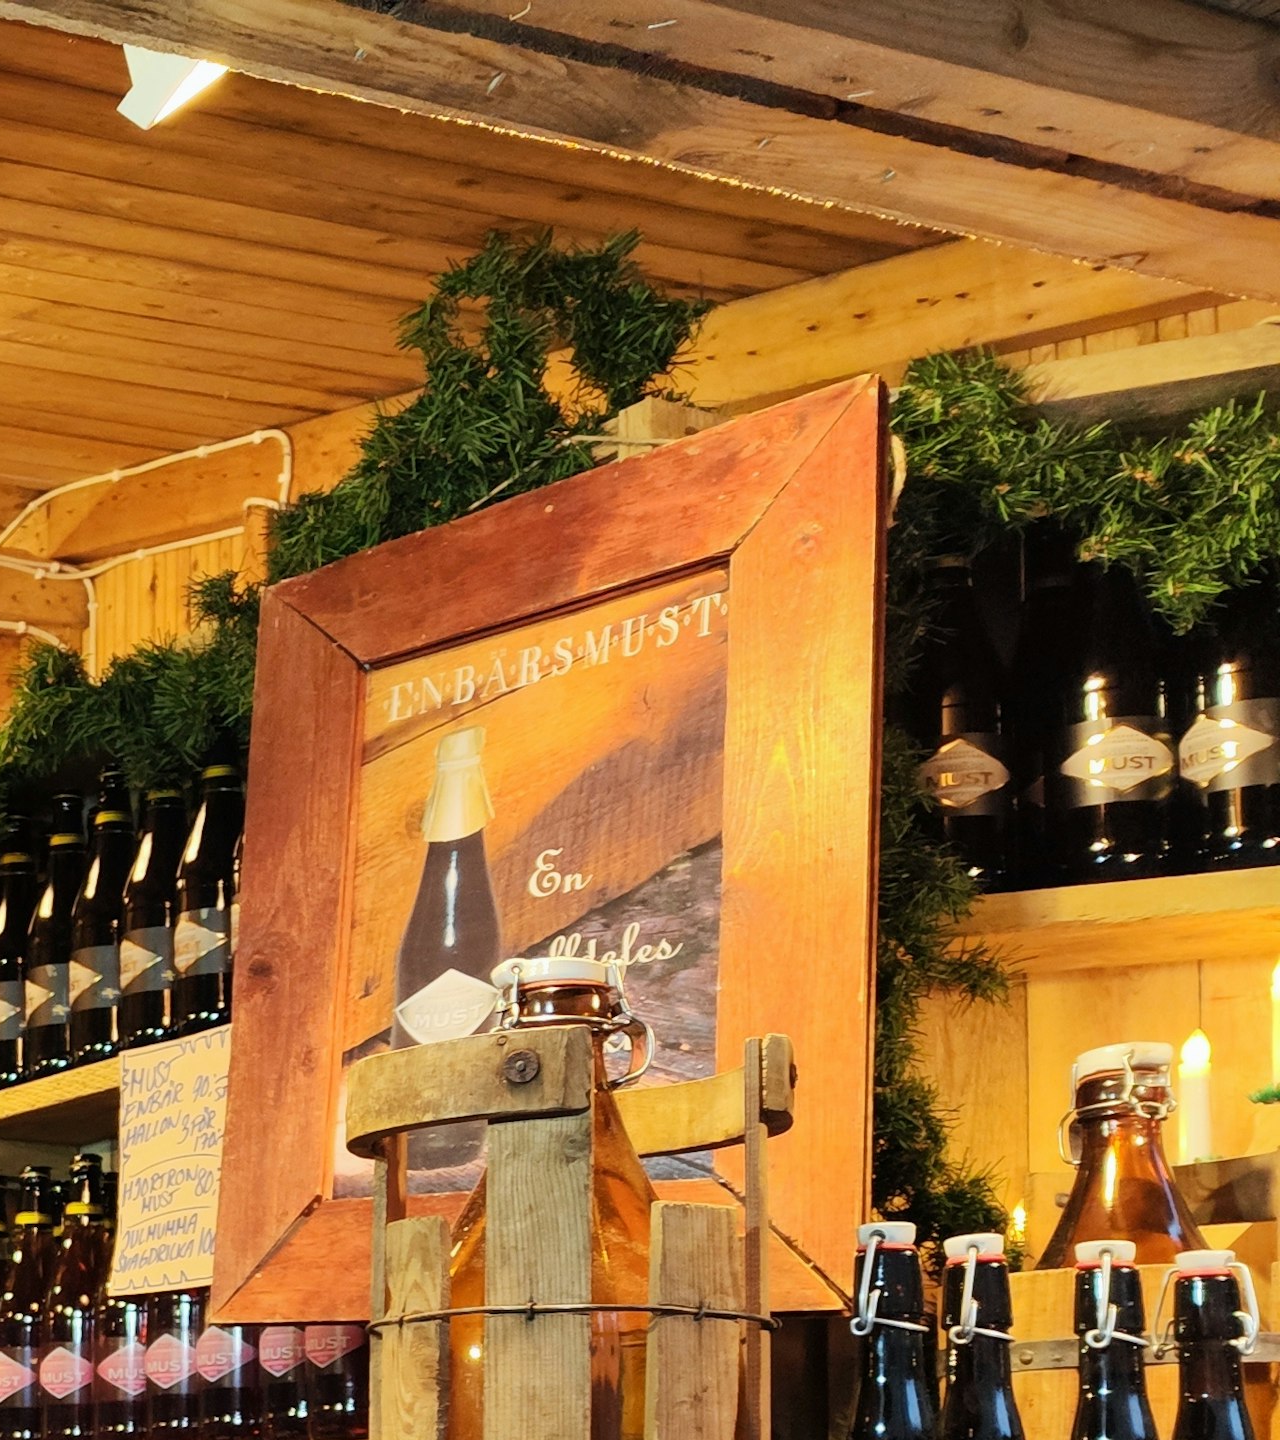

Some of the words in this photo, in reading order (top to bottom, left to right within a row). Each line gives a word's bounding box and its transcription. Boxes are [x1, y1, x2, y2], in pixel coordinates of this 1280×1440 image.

[528, 847, 593, 898] En
[414, 1005, 485, 1030] MUST
[107, 1367, 146, 1380] MUS
